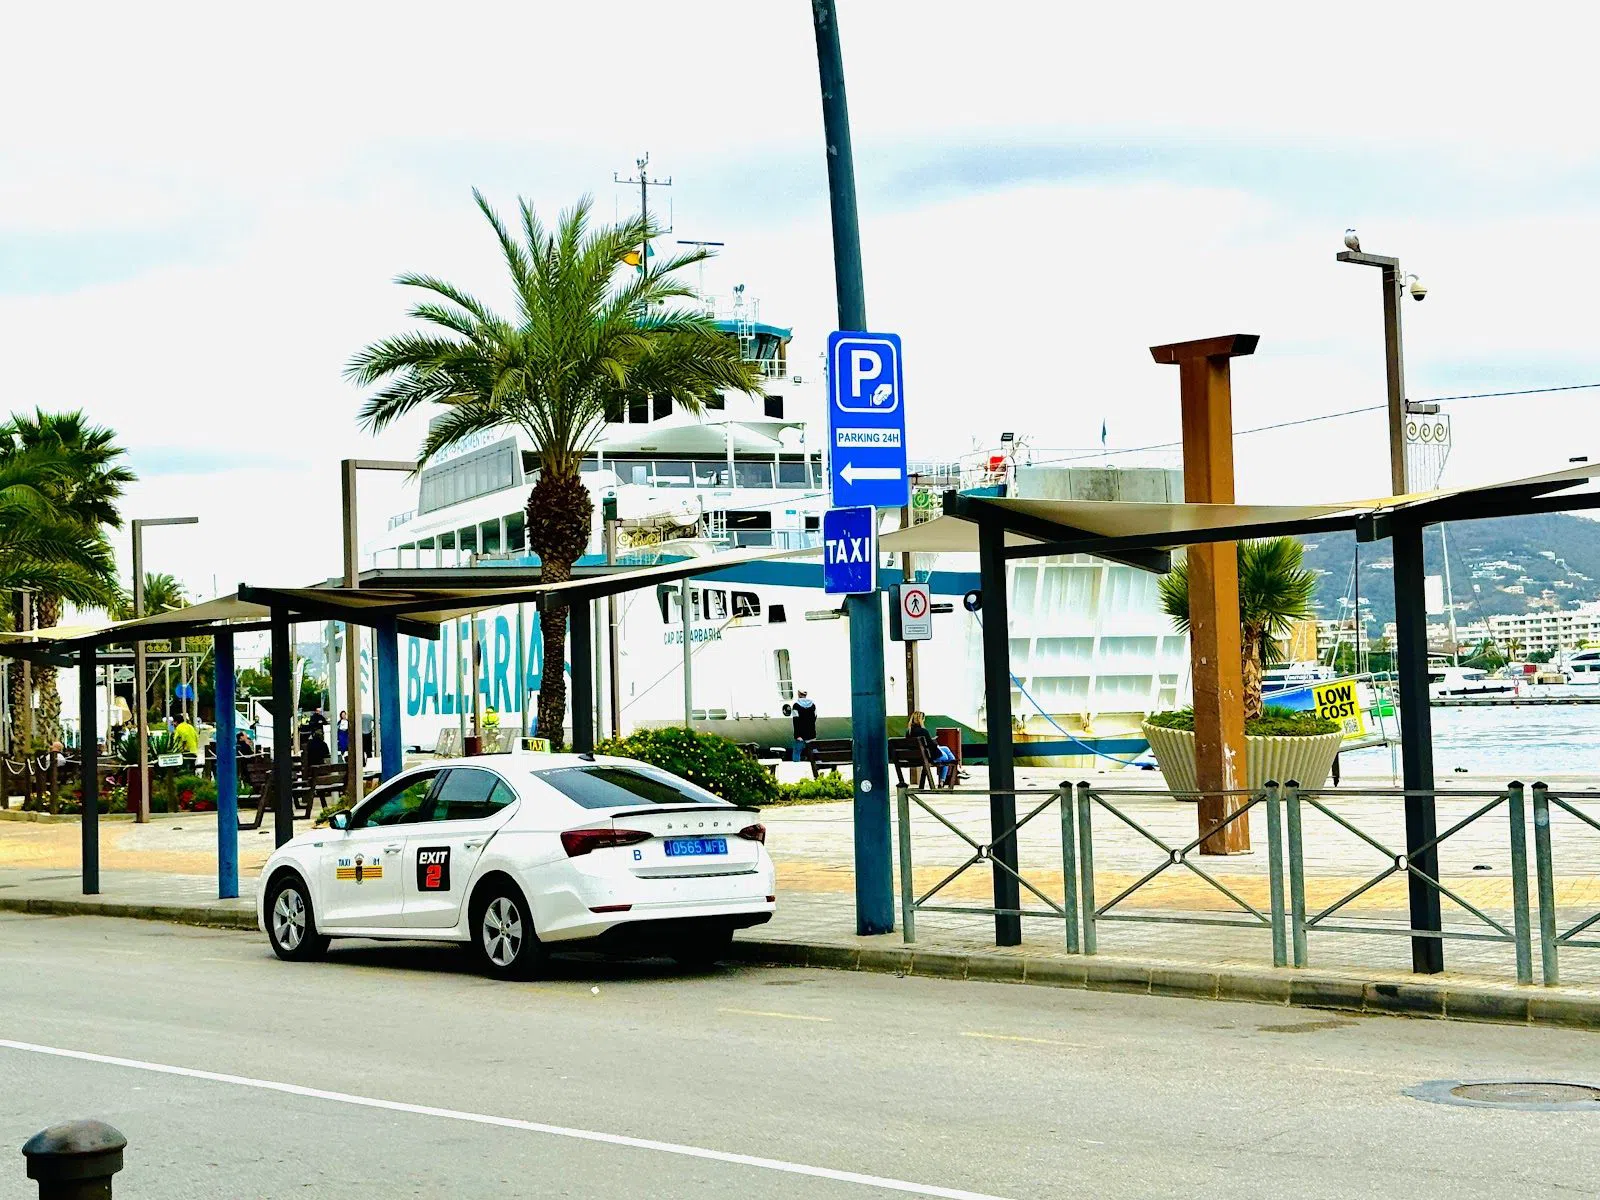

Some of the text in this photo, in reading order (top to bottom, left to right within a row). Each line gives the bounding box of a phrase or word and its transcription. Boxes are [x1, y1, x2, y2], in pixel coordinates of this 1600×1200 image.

[850, 349, 883, 398] P
[838, 432, 899, 443] PARKING 24H
[825, 536, 870, 565] TAXI
[663, 631, 675, 645] CAP
[686, 627, 722, 643] ARBARIA
[1316, 684, 1351, 707] LOW
[1320, 701, 1355, 721] COST
[527, 739, 546, 752] TAXI
[633, 849, 642, 861] B
[672, 839, 726, 855] 0565 MFB
[338, 858, 351, 867] TAXI
[425, 864, 442, 888] 2
